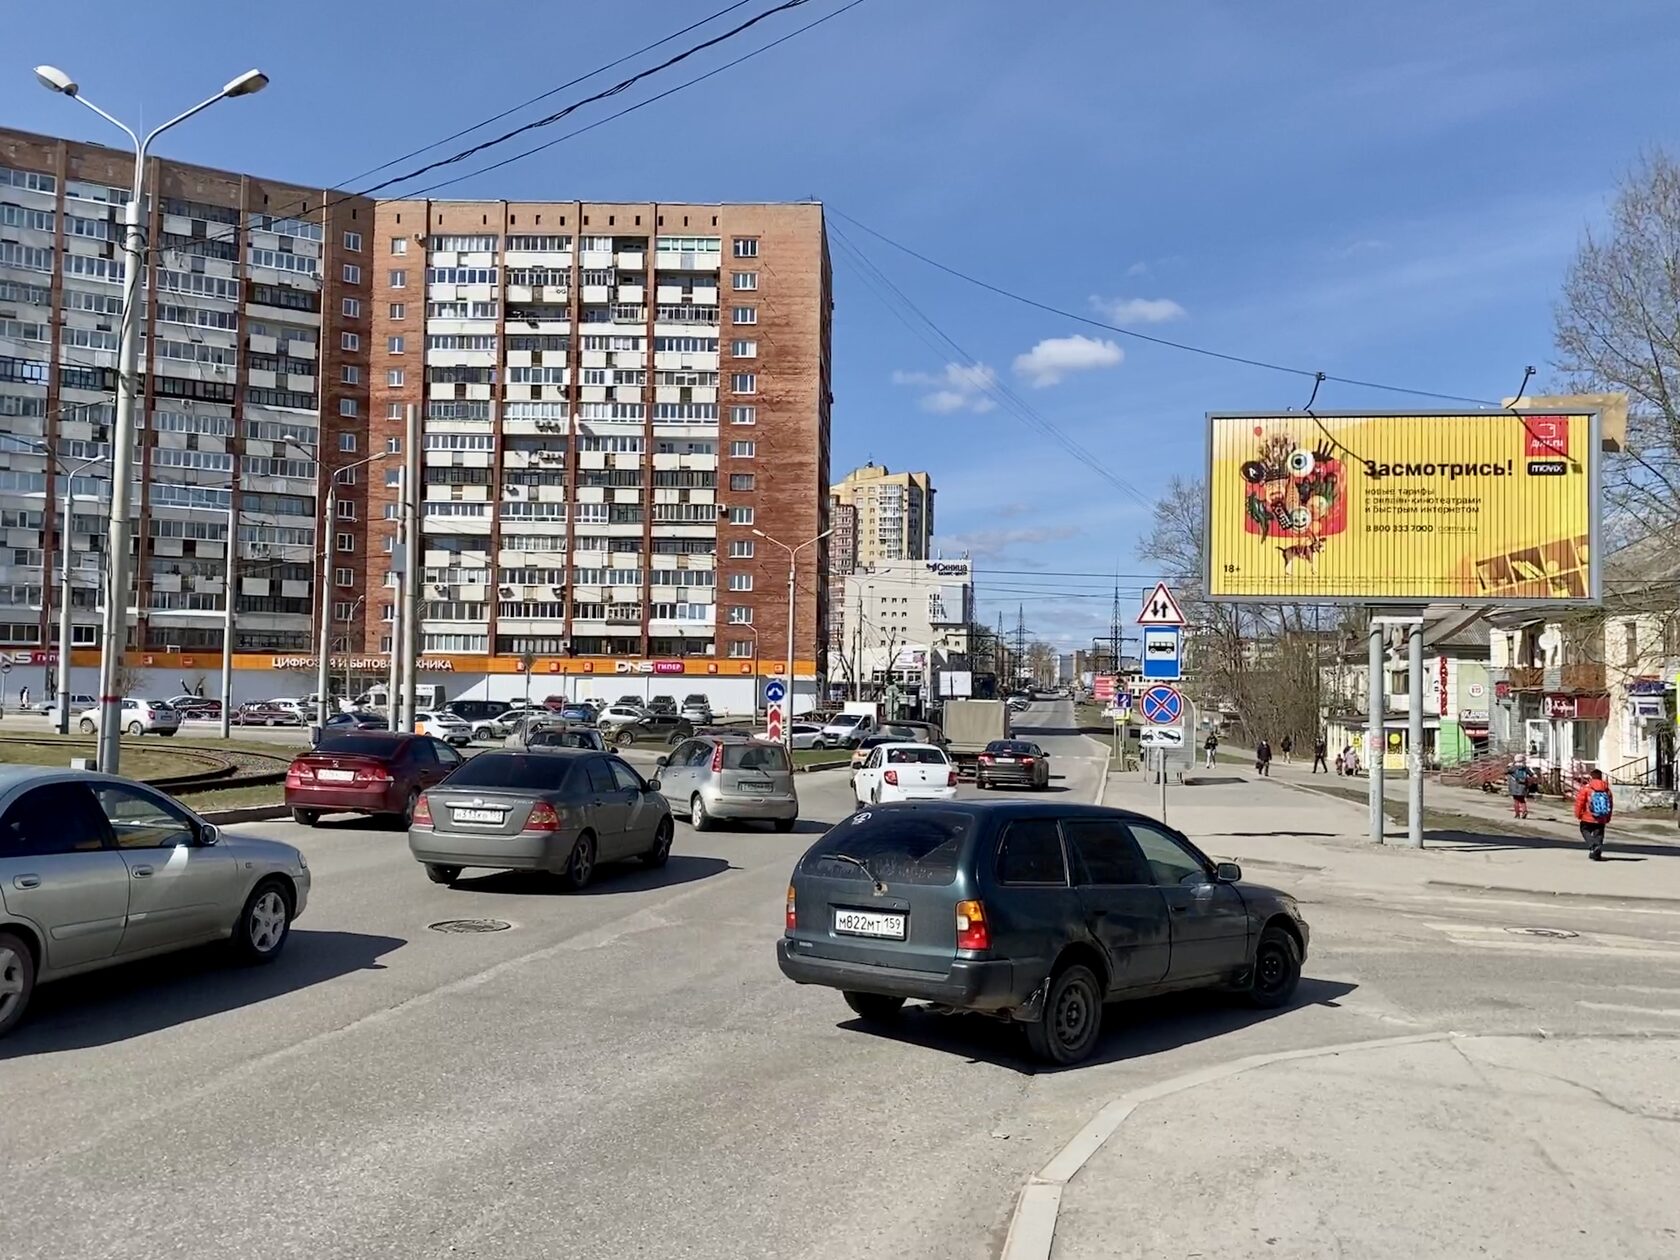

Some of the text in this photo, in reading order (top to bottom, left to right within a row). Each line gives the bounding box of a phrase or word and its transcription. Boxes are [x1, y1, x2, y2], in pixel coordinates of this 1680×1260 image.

[1364, 459, 1512, 480] Засмотрись!
[1224, 564, 1241, 573] 18+
[615, 661, 654, 673] DNS
[884, 917, 901, 930] 159
